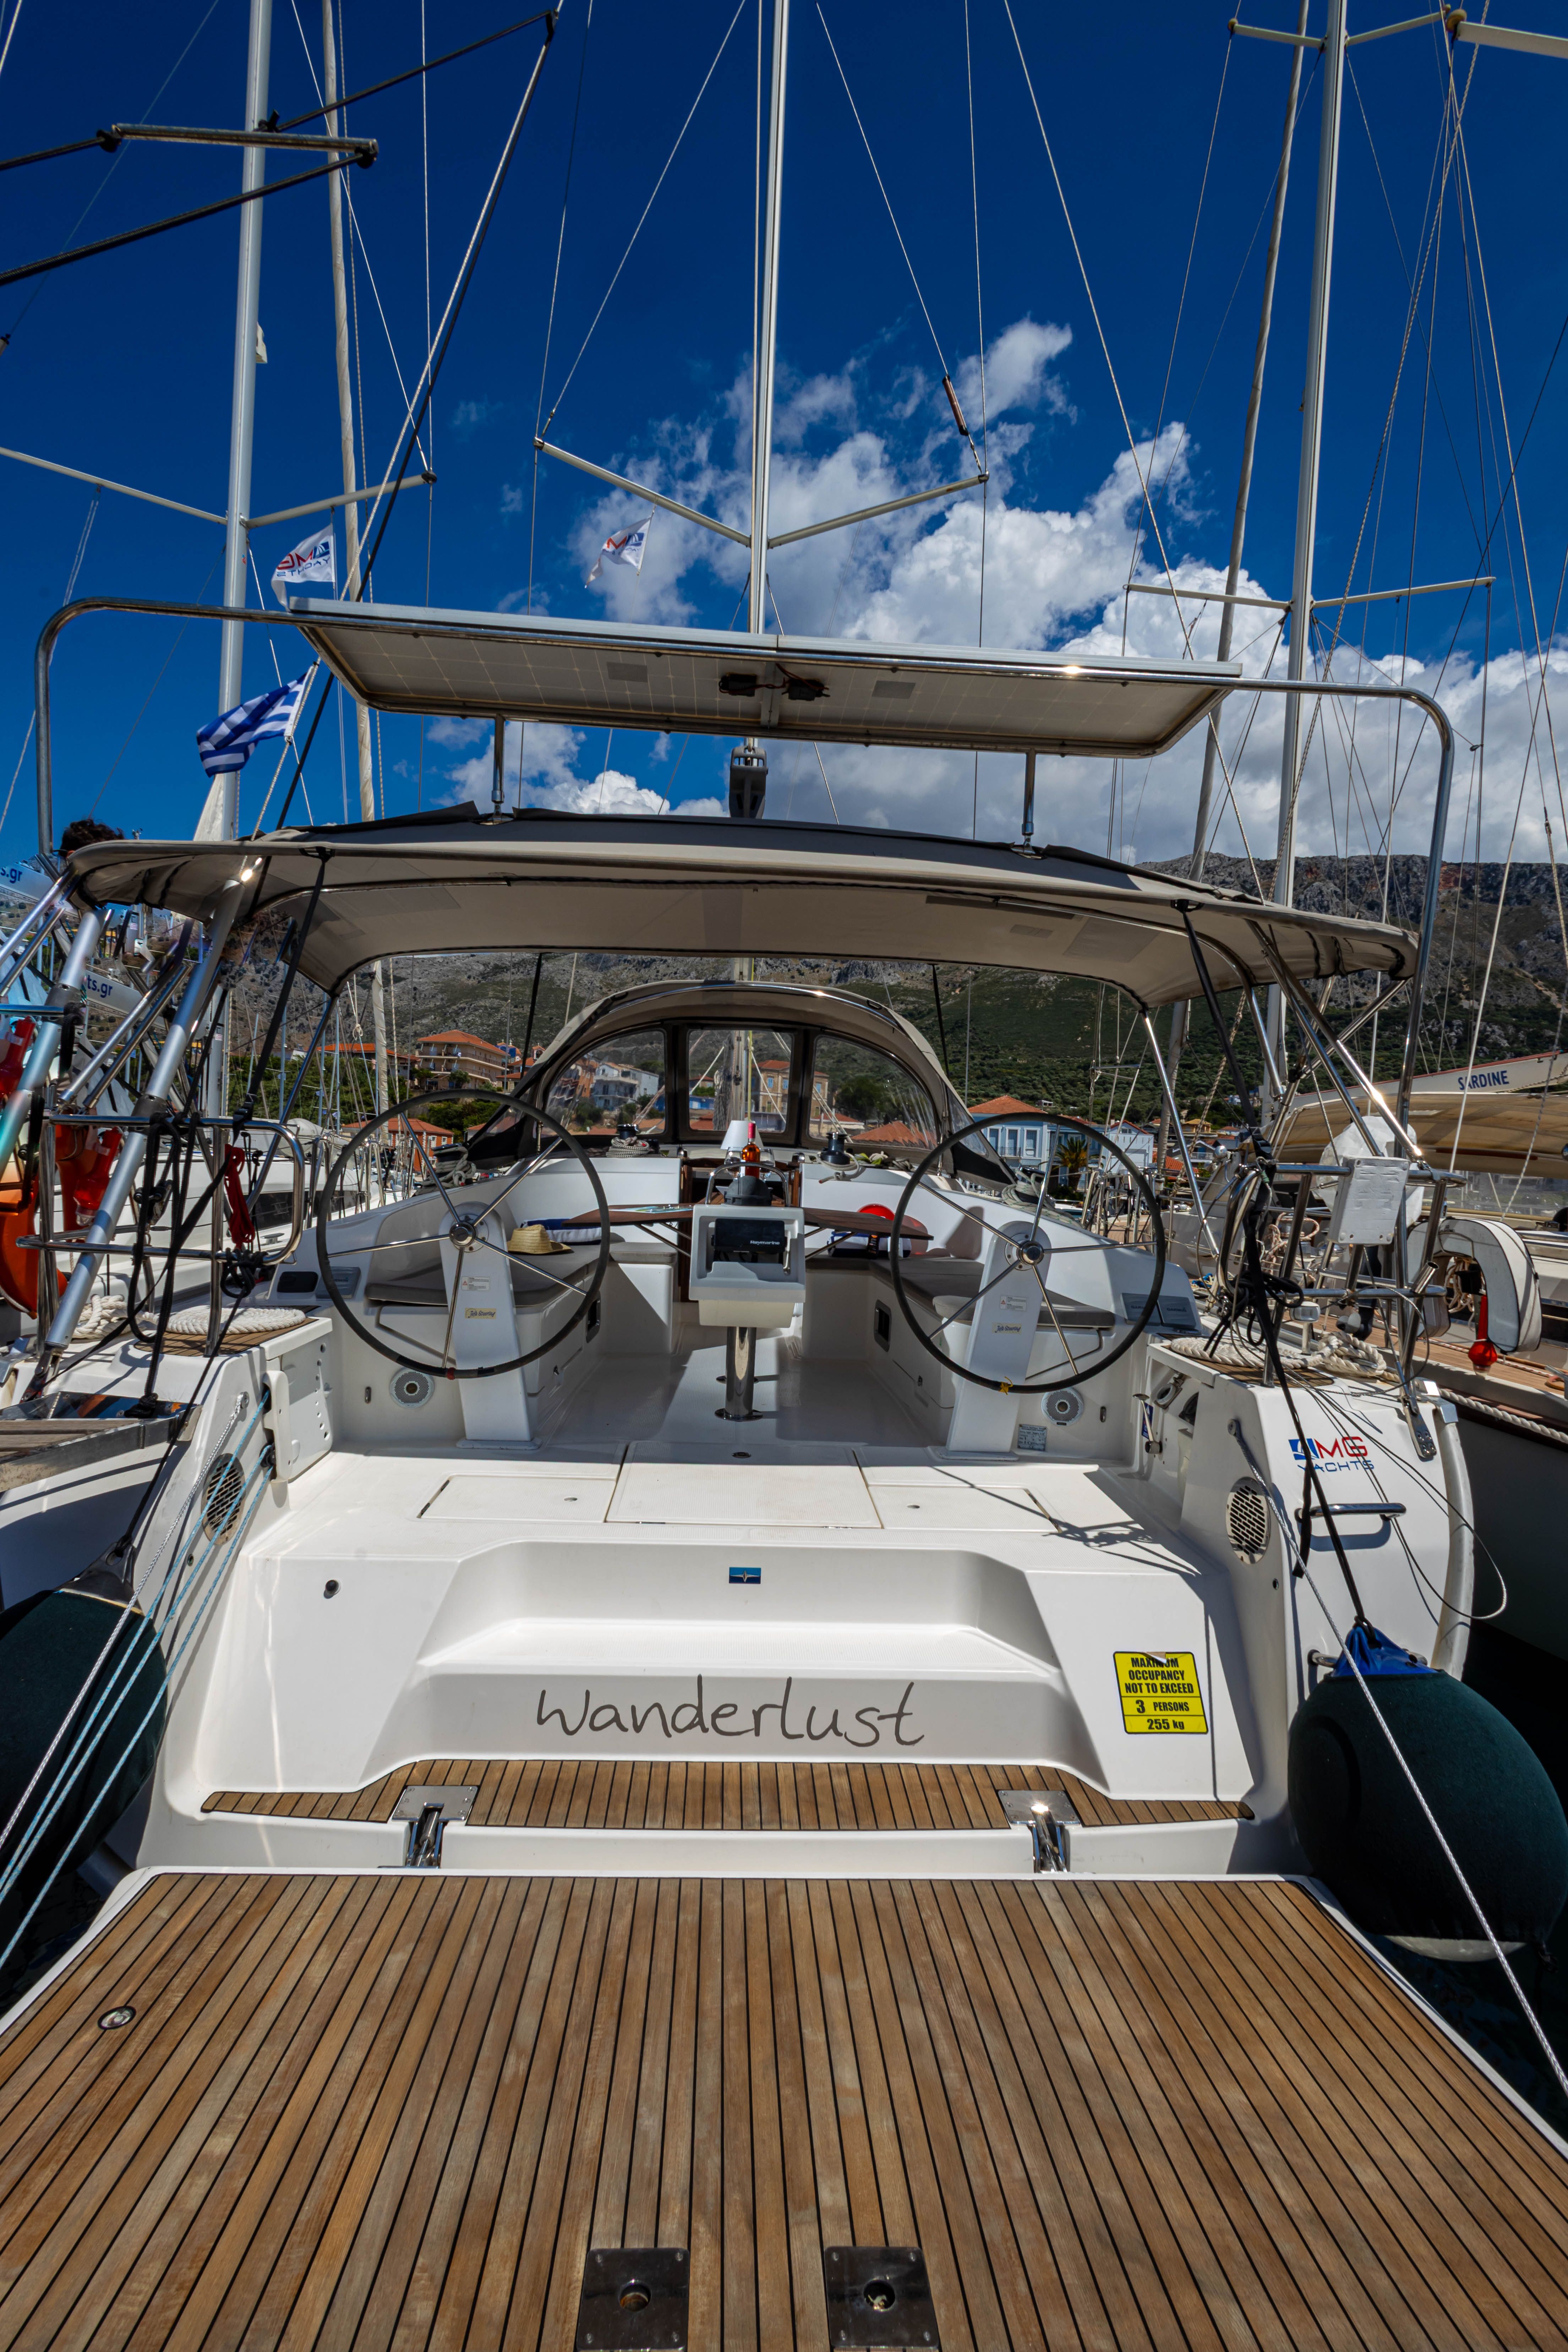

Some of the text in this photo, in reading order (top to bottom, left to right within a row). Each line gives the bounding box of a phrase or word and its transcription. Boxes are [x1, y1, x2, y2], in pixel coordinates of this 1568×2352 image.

[1128, 1670, 1185, 1681] OCCUPANCY
[1125, 1682, 1194, 1694] NOT TO EXCEED
[536, 1674, 925, 1747] Wanderlust
[1135, 1699, 1190, 1714] 3 PERSONS
[1147, 1719, 1185, 1730] 255 kg
